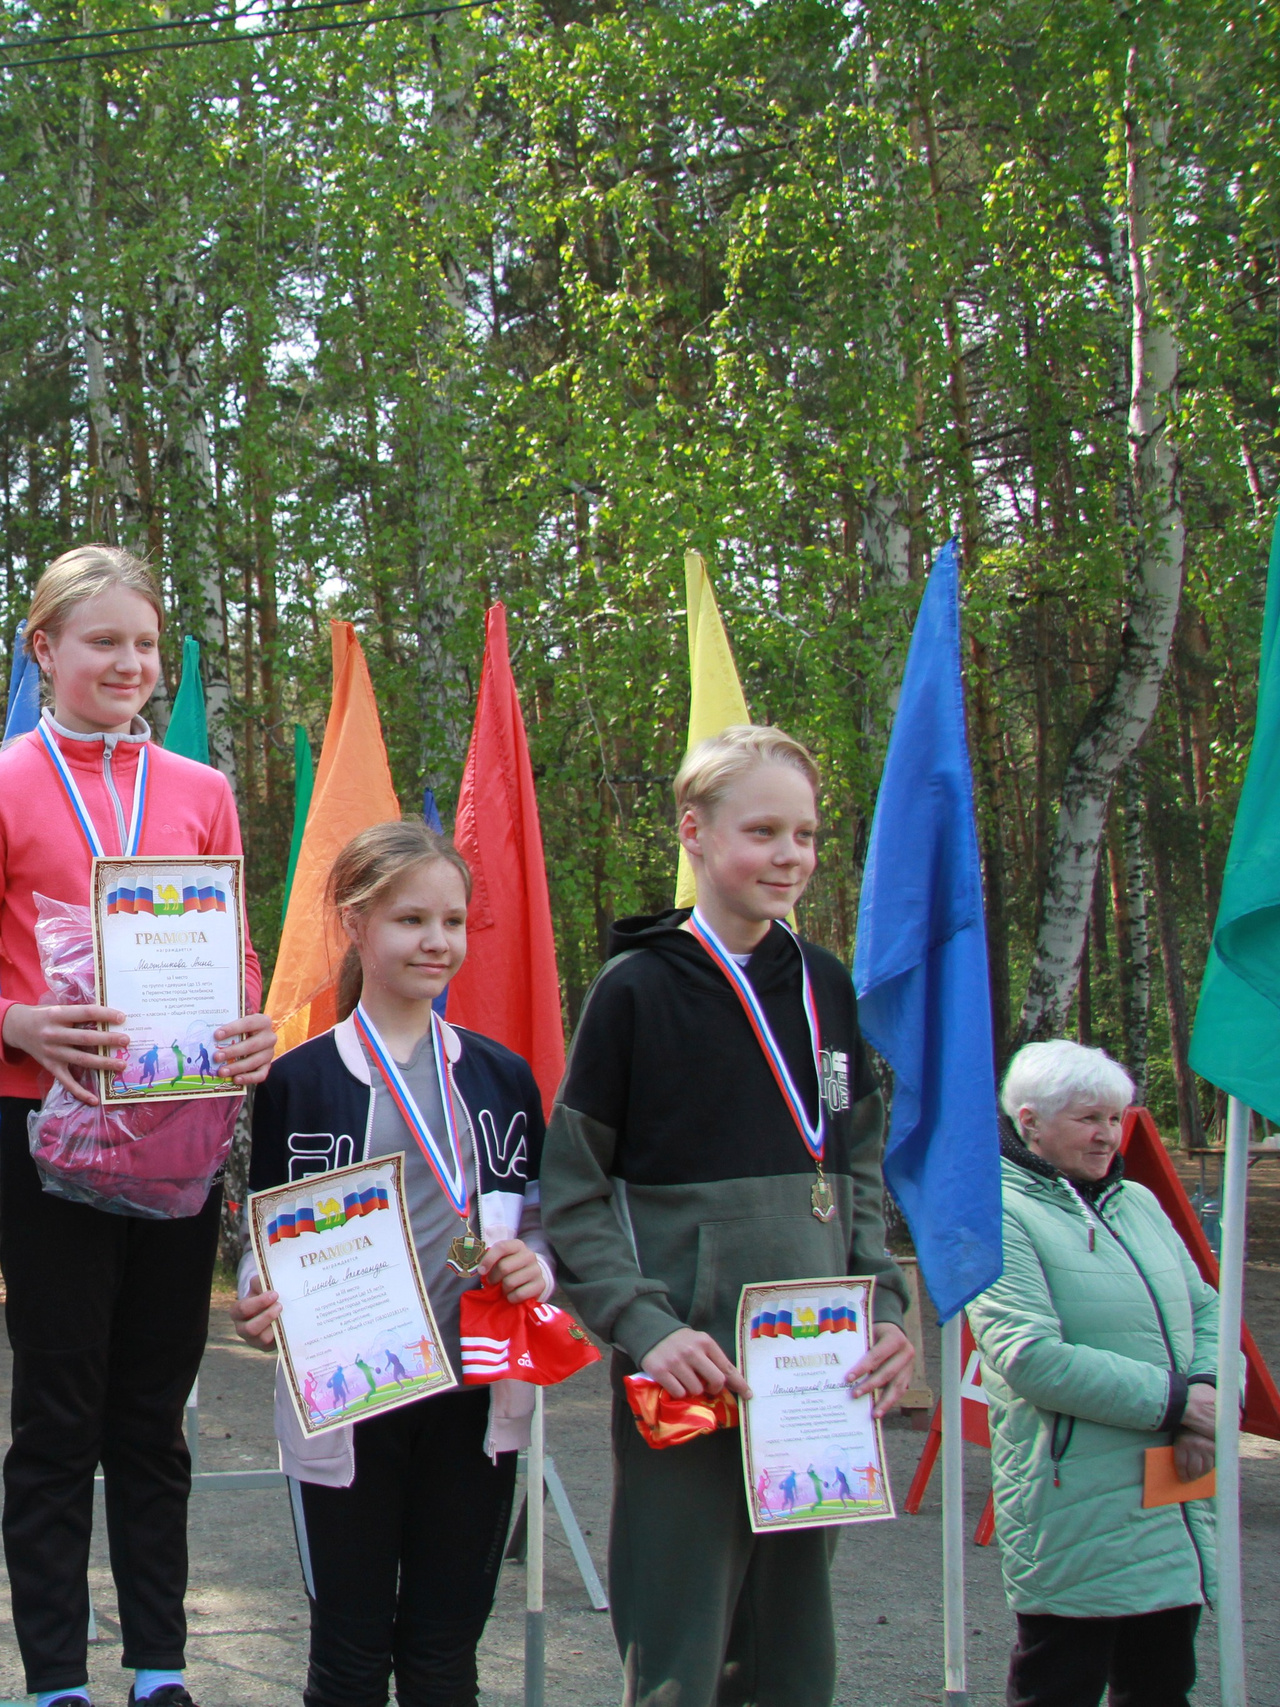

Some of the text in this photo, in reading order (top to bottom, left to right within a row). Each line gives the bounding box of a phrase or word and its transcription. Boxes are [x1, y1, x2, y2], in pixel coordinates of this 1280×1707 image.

[135, 931, 207, 944] ГРАМОТА
[299, 1234, 373, 1267] ГРАМОТА
[322, 1256, 358, 1270] награждается
[774, 1352, 838, 1368] ГРАМОТА
